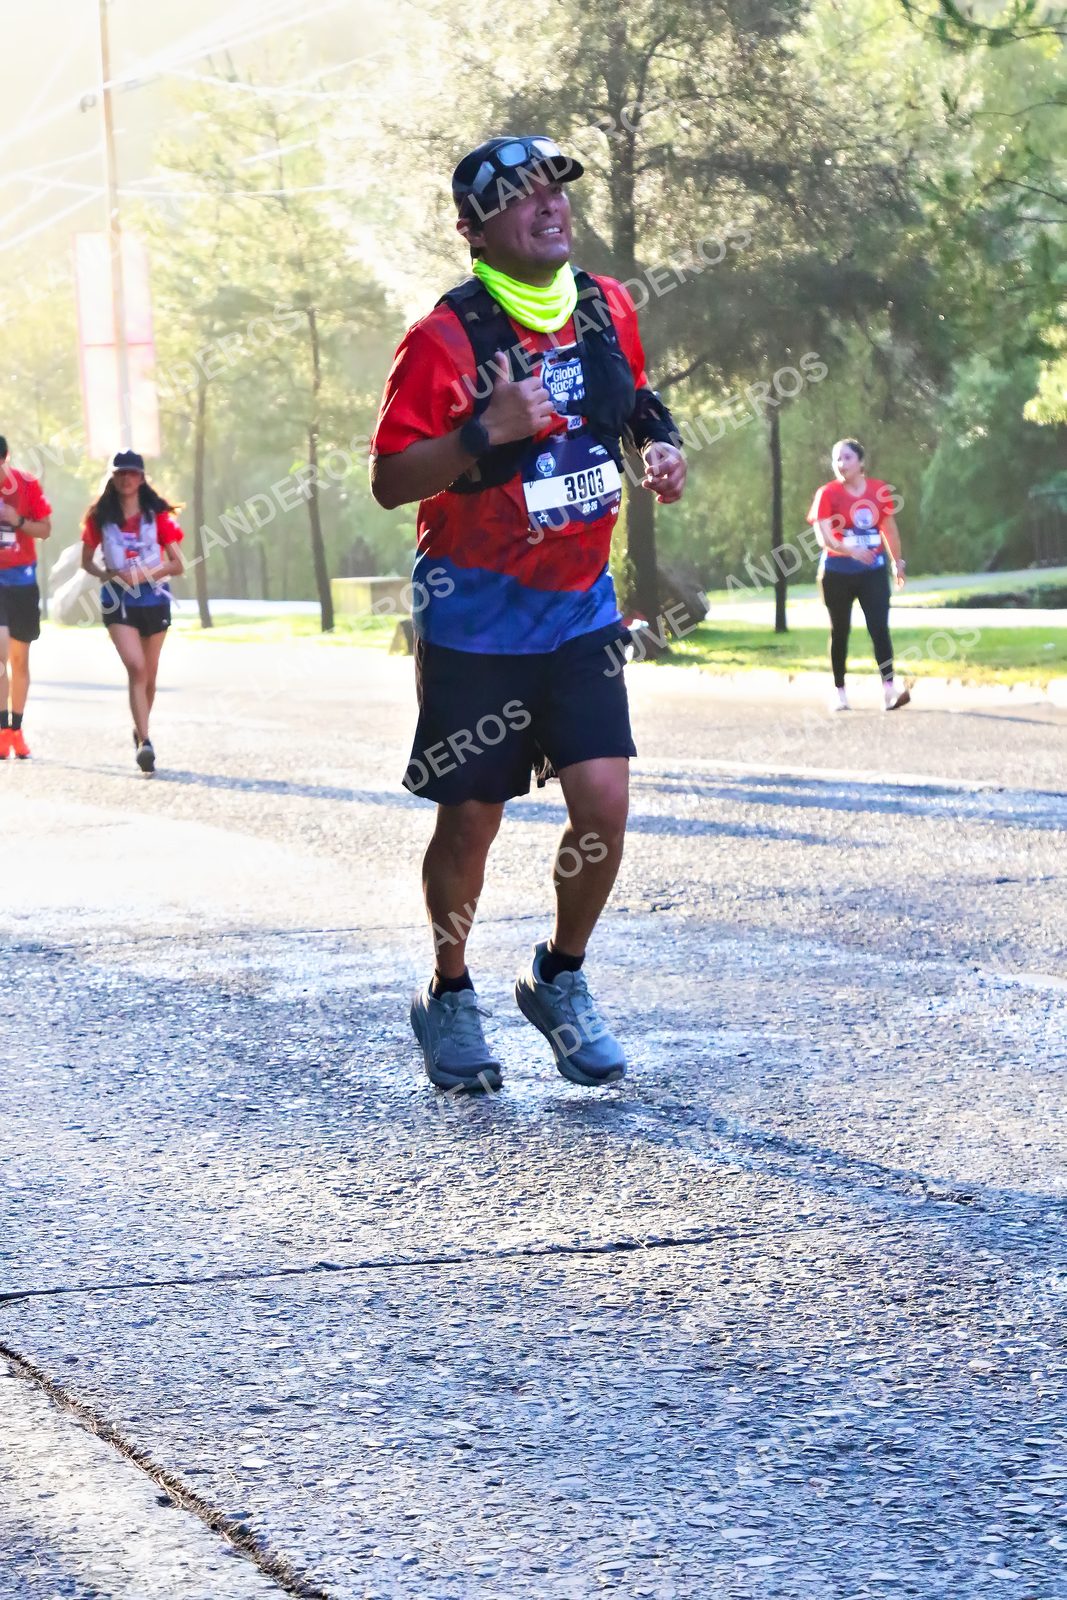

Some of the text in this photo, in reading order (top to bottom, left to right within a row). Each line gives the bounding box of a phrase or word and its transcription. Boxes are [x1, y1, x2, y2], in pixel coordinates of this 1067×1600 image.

[552, 362, 582, 383] Global
[550, 377, 574, 395] Race
[563, 467, 605, 502] 3903
